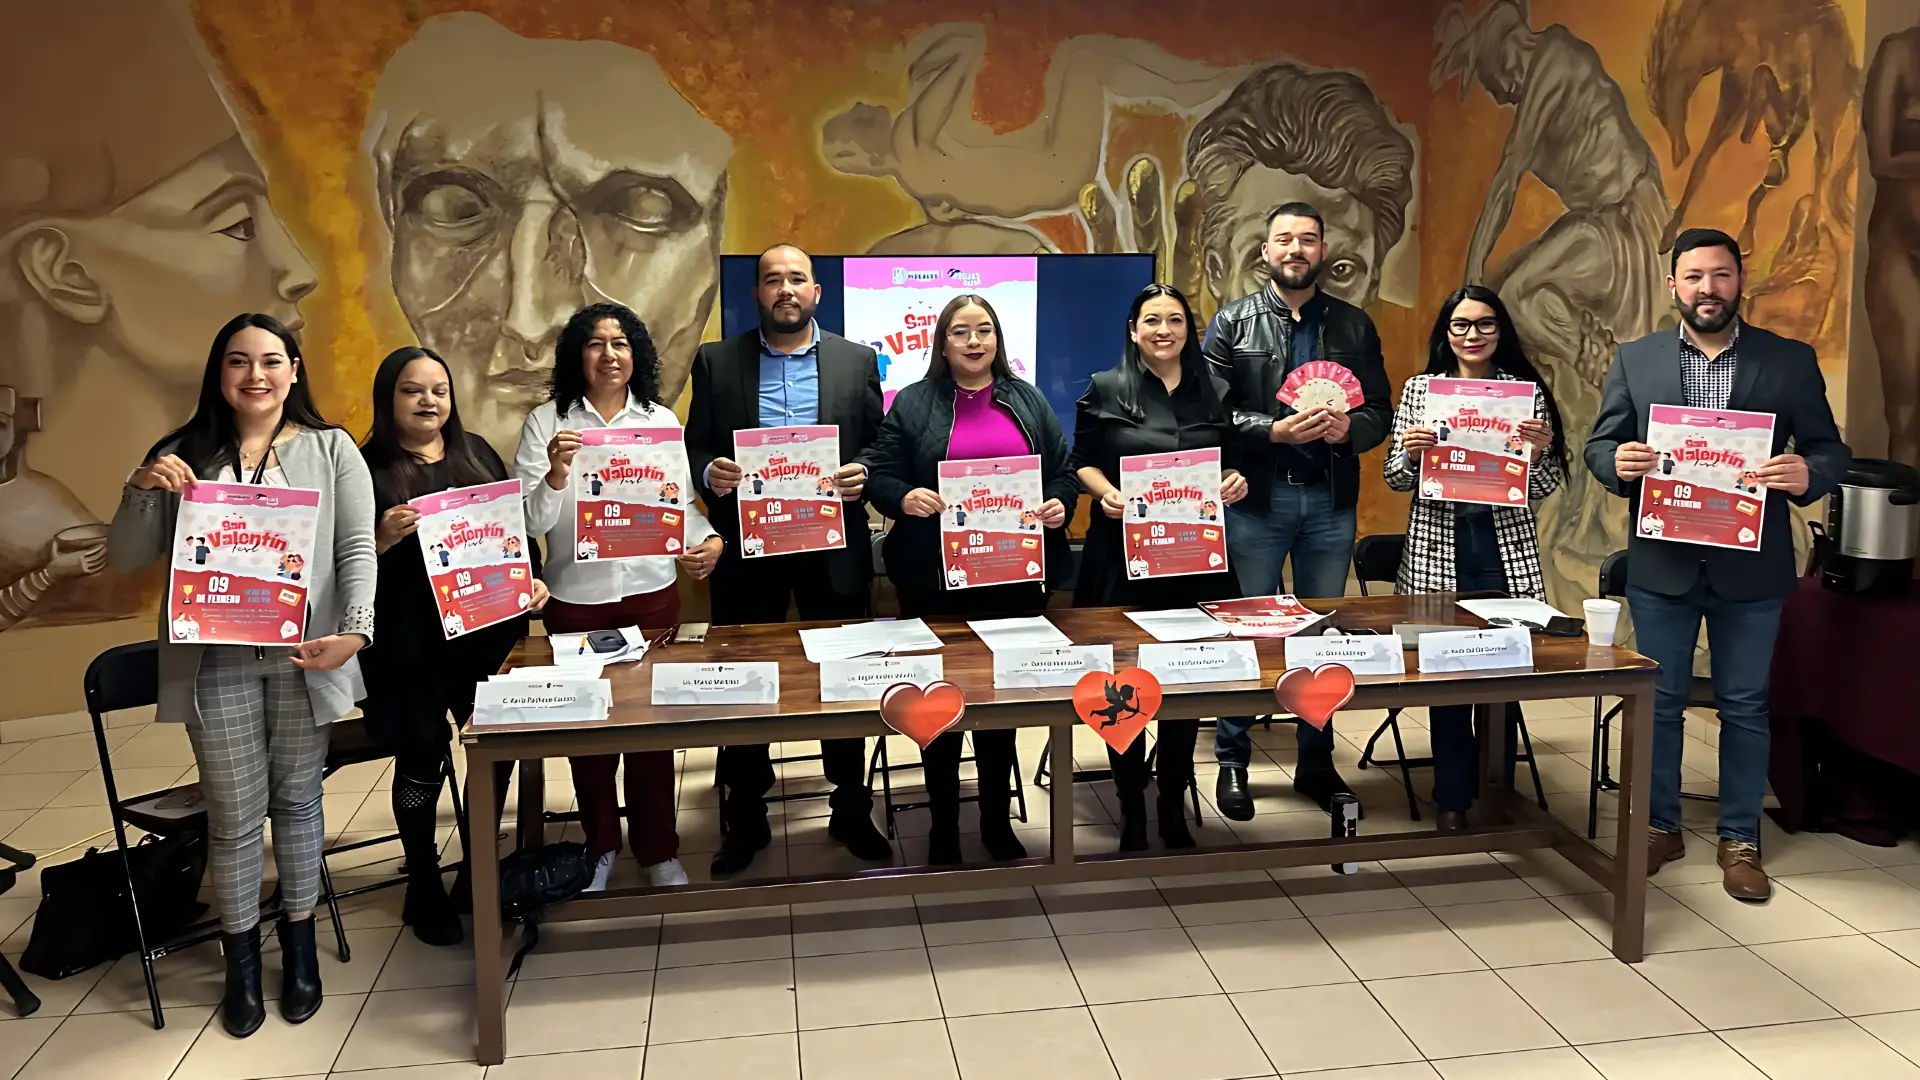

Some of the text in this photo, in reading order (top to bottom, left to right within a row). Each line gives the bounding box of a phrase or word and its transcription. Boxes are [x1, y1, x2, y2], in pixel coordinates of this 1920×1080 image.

[904, 313, 937, 329] San
[1459, 408, 1478, 416] San
[1448, 416, 1511, 433] Valentín
[1685, 439, 1708, 447] San
[610, 458, 630, 467] San
[768, 457, 787, 466] San
[1450, 450, 1466, 463] 09
[1672, 449, 1745, 468] Valentín
[600, 465, 665, 482] Valentín
[759, 462, 820, 480] Valentín
[1152, 480, 1170, 490] San
[972, 488, 990, 498] San
[1143, 486, 1203, 504] Valentín
[1674, 485, 1691, 499] 09
[767, 501, 781, 514] 09
[962, 494, 1023, 512] Valentín
[605, 504, 620, 517] 09
[222, 520, 246, 530] San
[450, 520, 469, 532] San
[1151, 525, 1165, 537] 09
[207, 531, 288, 552] Valentín
[442, 523, 504, 550] Valentín
[969, 533, 983, 545] 09
[209, 576, 229, 593] 09
[456, 571, 471, 587] 09
